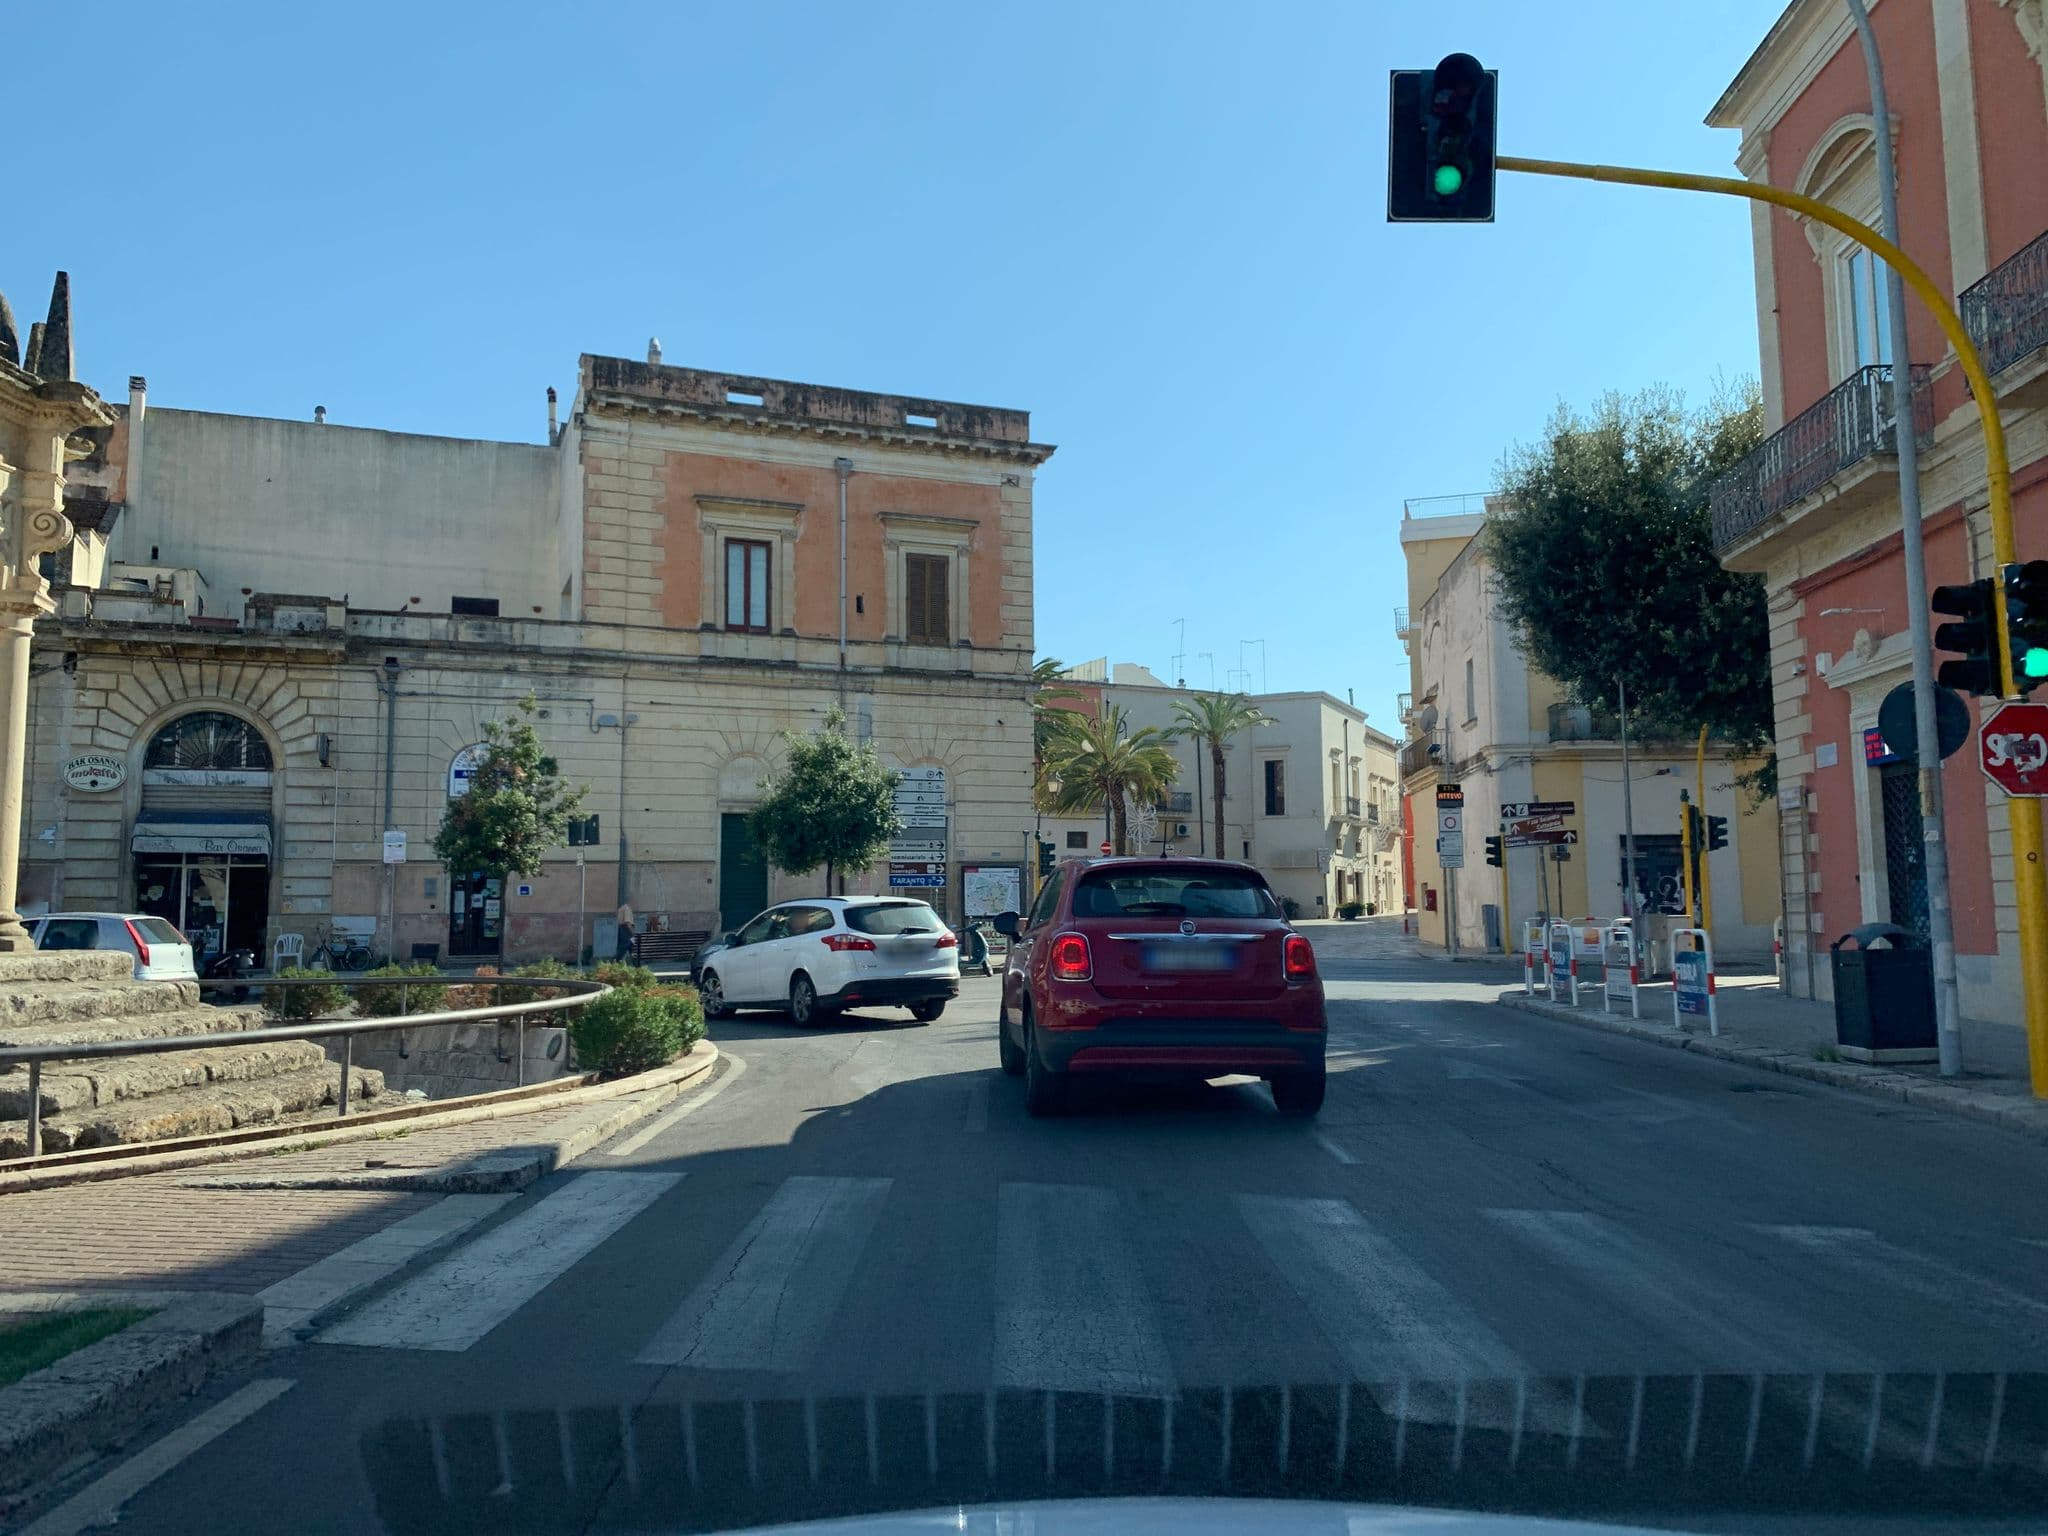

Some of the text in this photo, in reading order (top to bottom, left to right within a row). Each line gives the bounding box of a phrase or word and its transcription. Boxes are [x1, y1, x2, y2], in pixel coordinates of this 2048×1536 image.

[68, 756, 121, 770] BAR OSANNA
[200, 839, 223, 852] Bar
[893, 877, 926, 885] TARANTO
